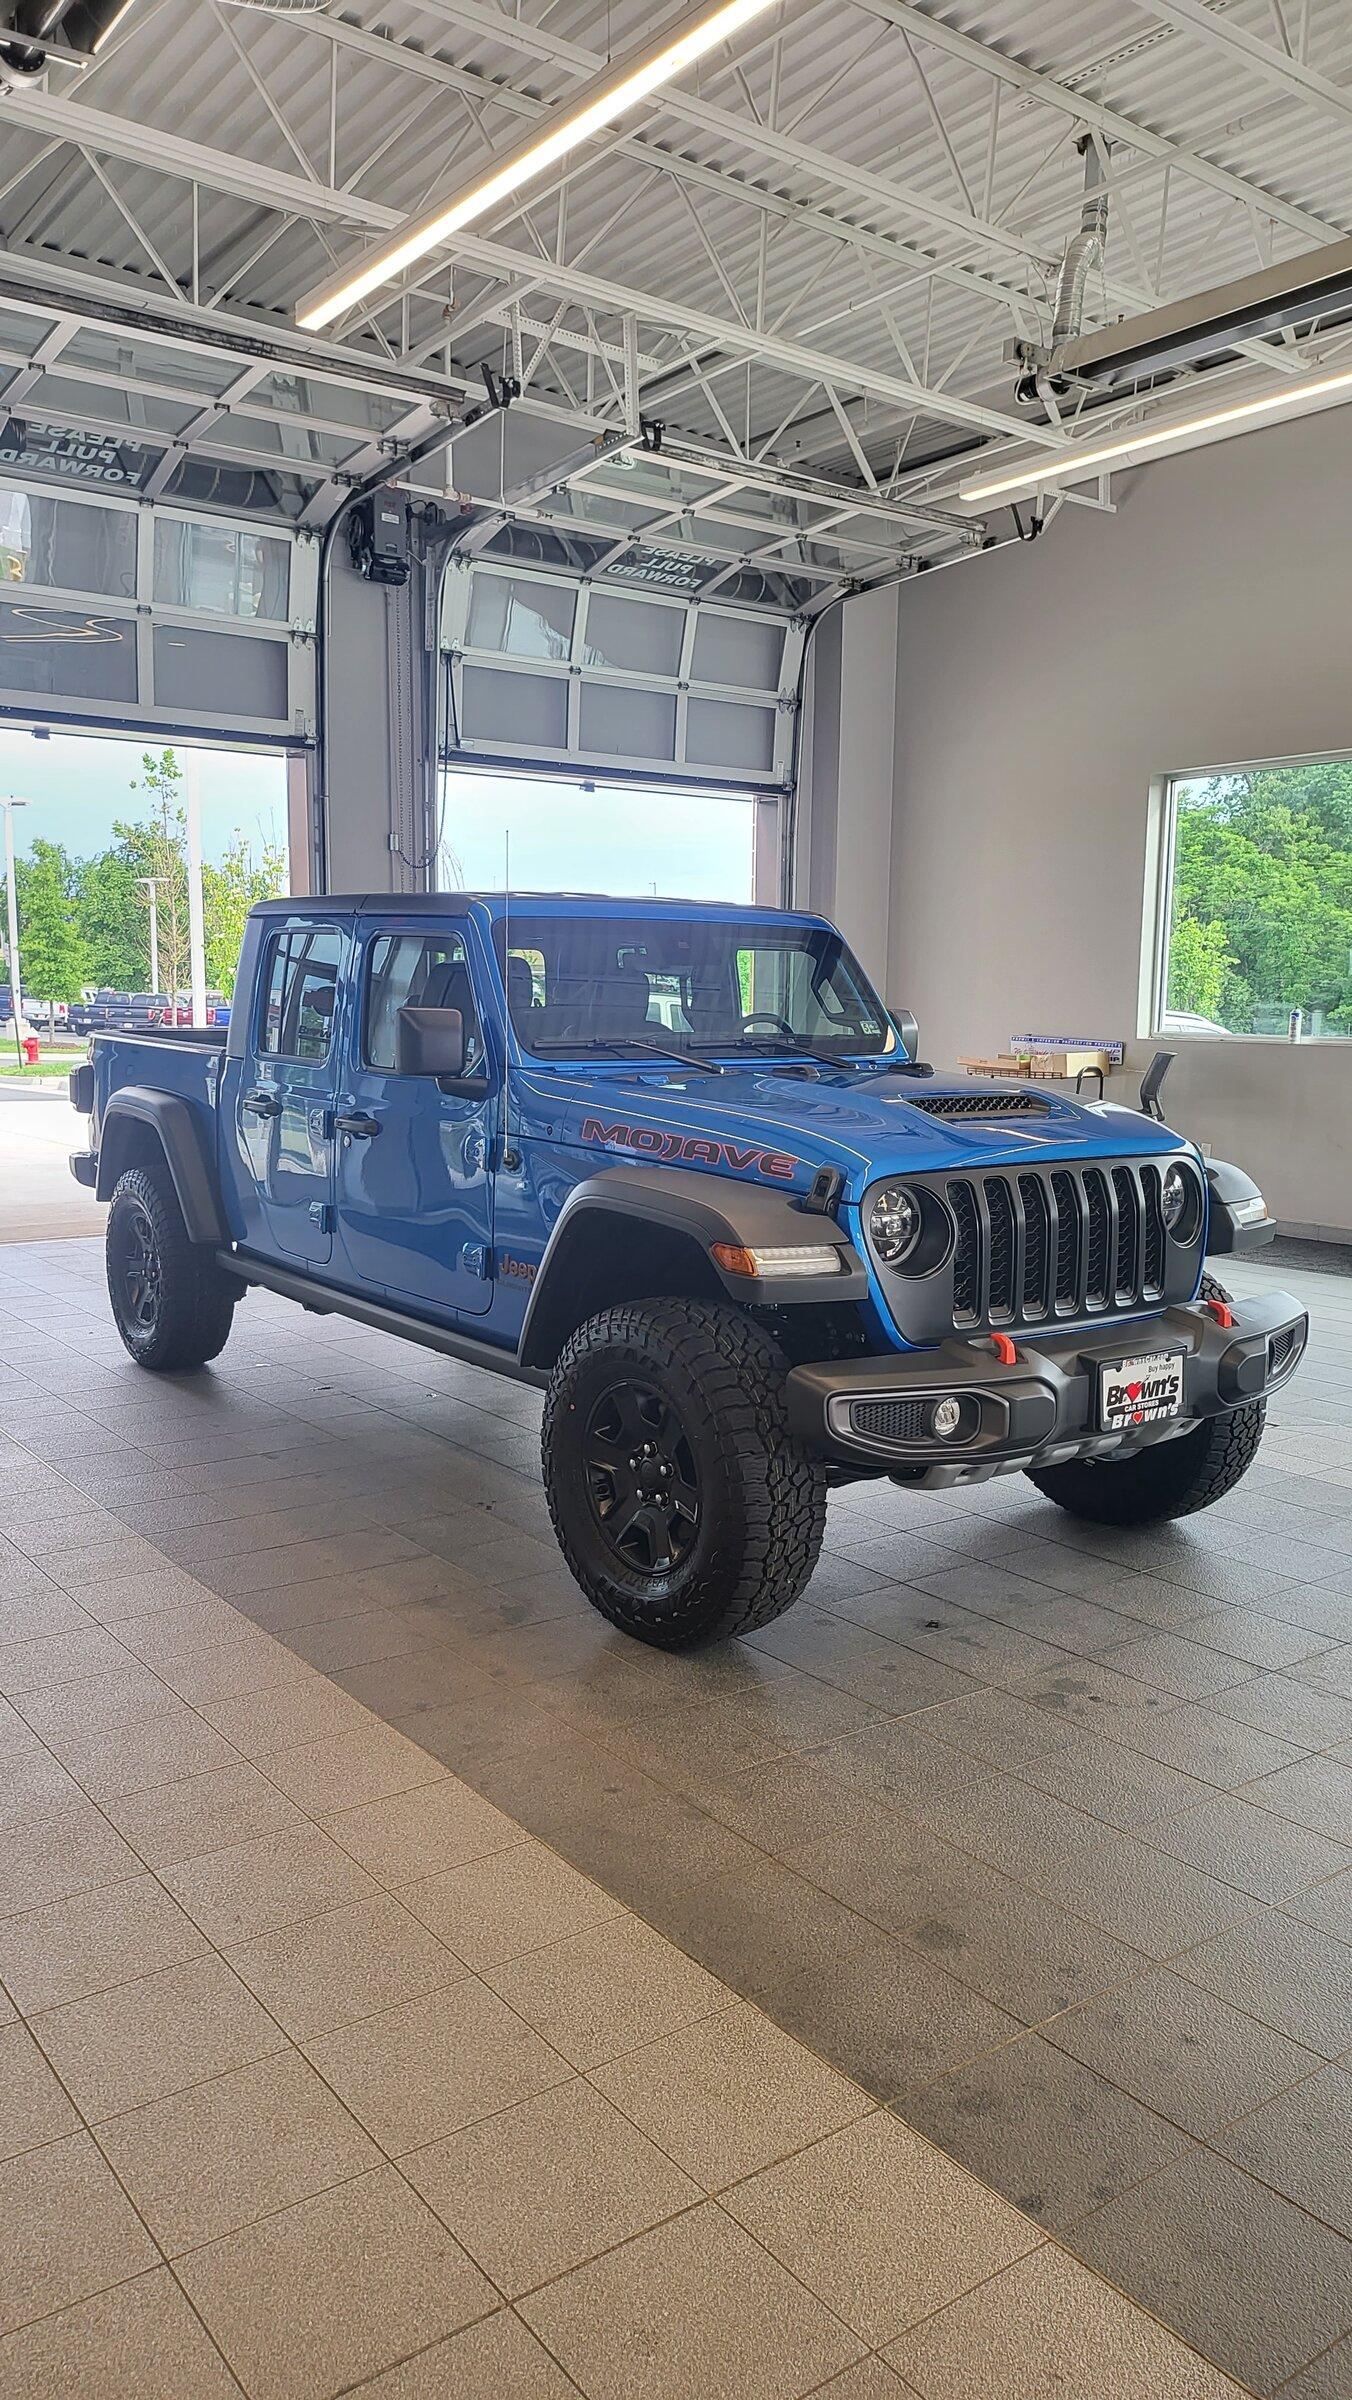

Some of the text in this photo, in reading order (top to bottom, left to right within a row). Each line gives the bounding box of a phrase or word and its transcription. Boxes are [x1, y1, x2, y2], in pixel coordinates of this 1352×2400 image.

[581, 1118, 800, 1180] MOJAVE
[499, 1253, 538, 1285] Jeep
[1148, 1362, 1175, 1373] Buy happy
[1124, 1400, 1160, 1412] CAR STORES
